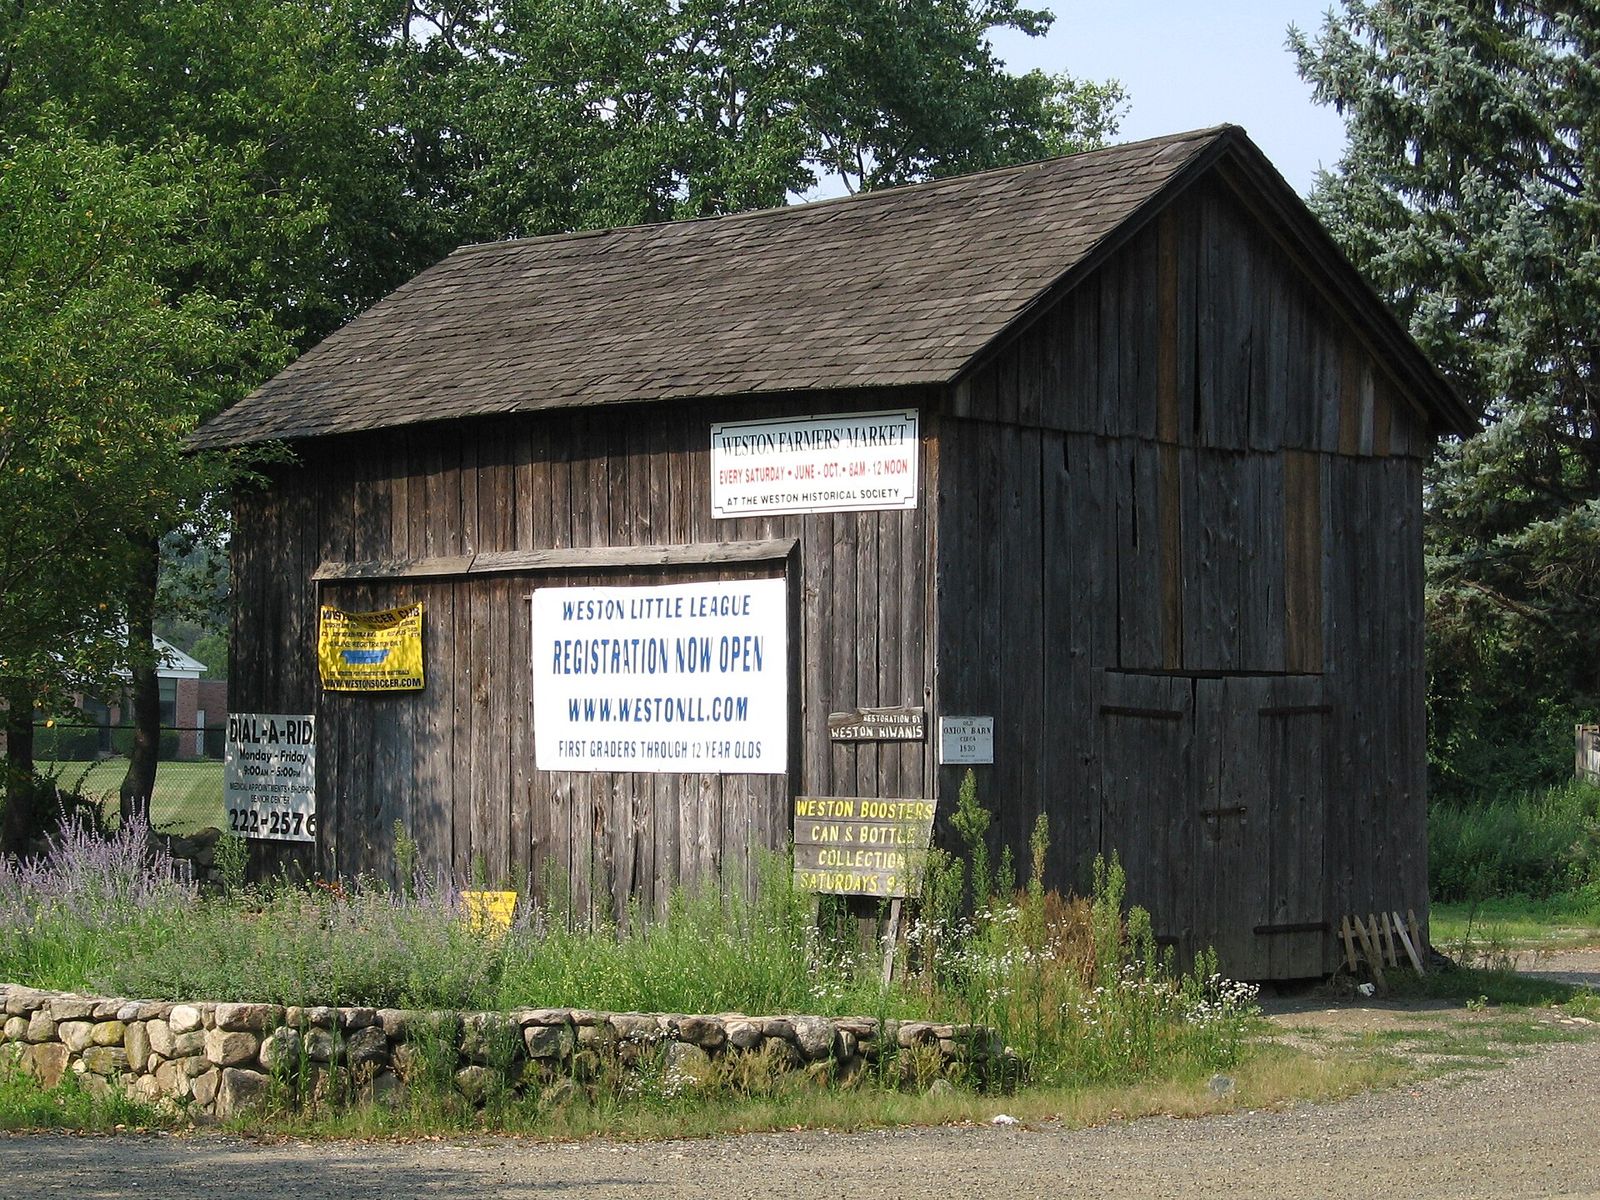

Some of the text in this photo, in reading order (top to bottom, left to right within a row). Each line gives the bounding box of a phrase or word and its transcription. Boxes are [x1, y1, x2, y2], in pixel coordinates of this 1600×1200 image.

[722, 424, 907, 457] WESTON FARMERS' MARKET
[719, 468, 743, 485] EVERY
[745, 466, 785, 483] SATURDAY
[794, 464, 815, 480] JUNE
[873, 460, 882, 475] 12
[884, 458, 908, 475] NOON
[727, 488, 900, 506] AT THE WESTON HISTORICAL SOCIETY
[562, 595, 751, 621] WESTON LITTLE LEAGUE
[553, 635, 764, 675] REGISTRATION NOW OPEN
[568, 697, 749, 723] WWW.WESTONLL.COM
[863, 714, 910, 724] RESTORATION
[229, 718, 316, 746] DIAL-A-RID
[831, 725, 923, 739] WESTON KIWANIS
[943, 727, 966, 735] ONION
[240, 749, 272, 763] Monday
[280, 750, 307, 765] Friday
[559, 741, 762, 759] FIRST GRADERS THROUGH 12 YEAR OLDS
[797, 801, 933, 819] WESTON BOOSTERS
[230, 808, 317, 837] 222-2576
[812, 825, 839, 841] CAN
[860, 826, 916, 843] BOTTLE
[819, 849, 906, 868] COLLECTION
[801, 872, 878, 893] SATURDAYS
